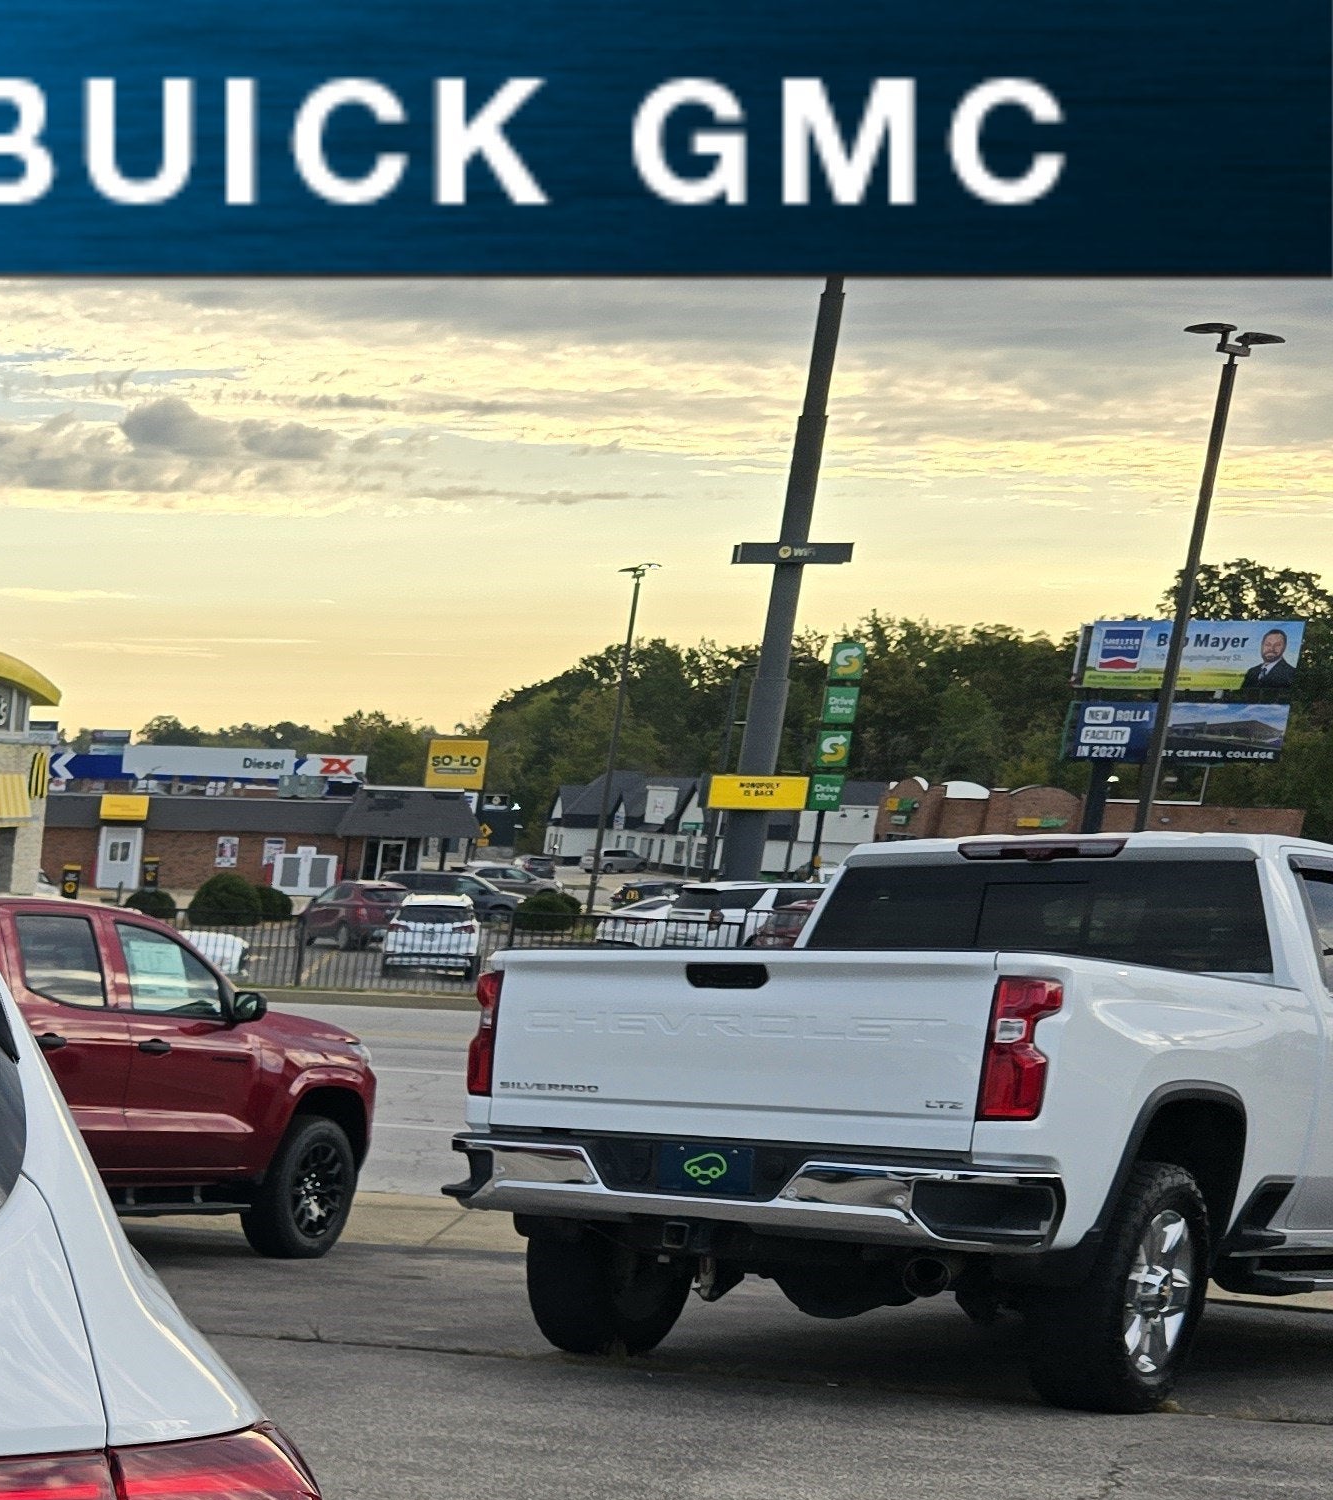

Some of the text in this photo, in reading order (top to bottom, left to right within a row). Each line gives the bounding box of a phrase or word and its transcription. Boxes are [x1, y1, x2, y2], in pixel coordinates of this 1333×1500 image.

[1193, 633, 1249, 651] Mayer
[1115, 709, 1150, 722] ROLLA
[1076, 745, 1127, 759] IN 2027!
[1176, 749, 1224, 759] CENTRAL
[1226, 750, 1274, 760] COLLEGE
[242, 757, 285, 770] Diesel
[431, 754, 482, 768] SO-LO
[499, 1081, 600, 1093] SILVERADO
